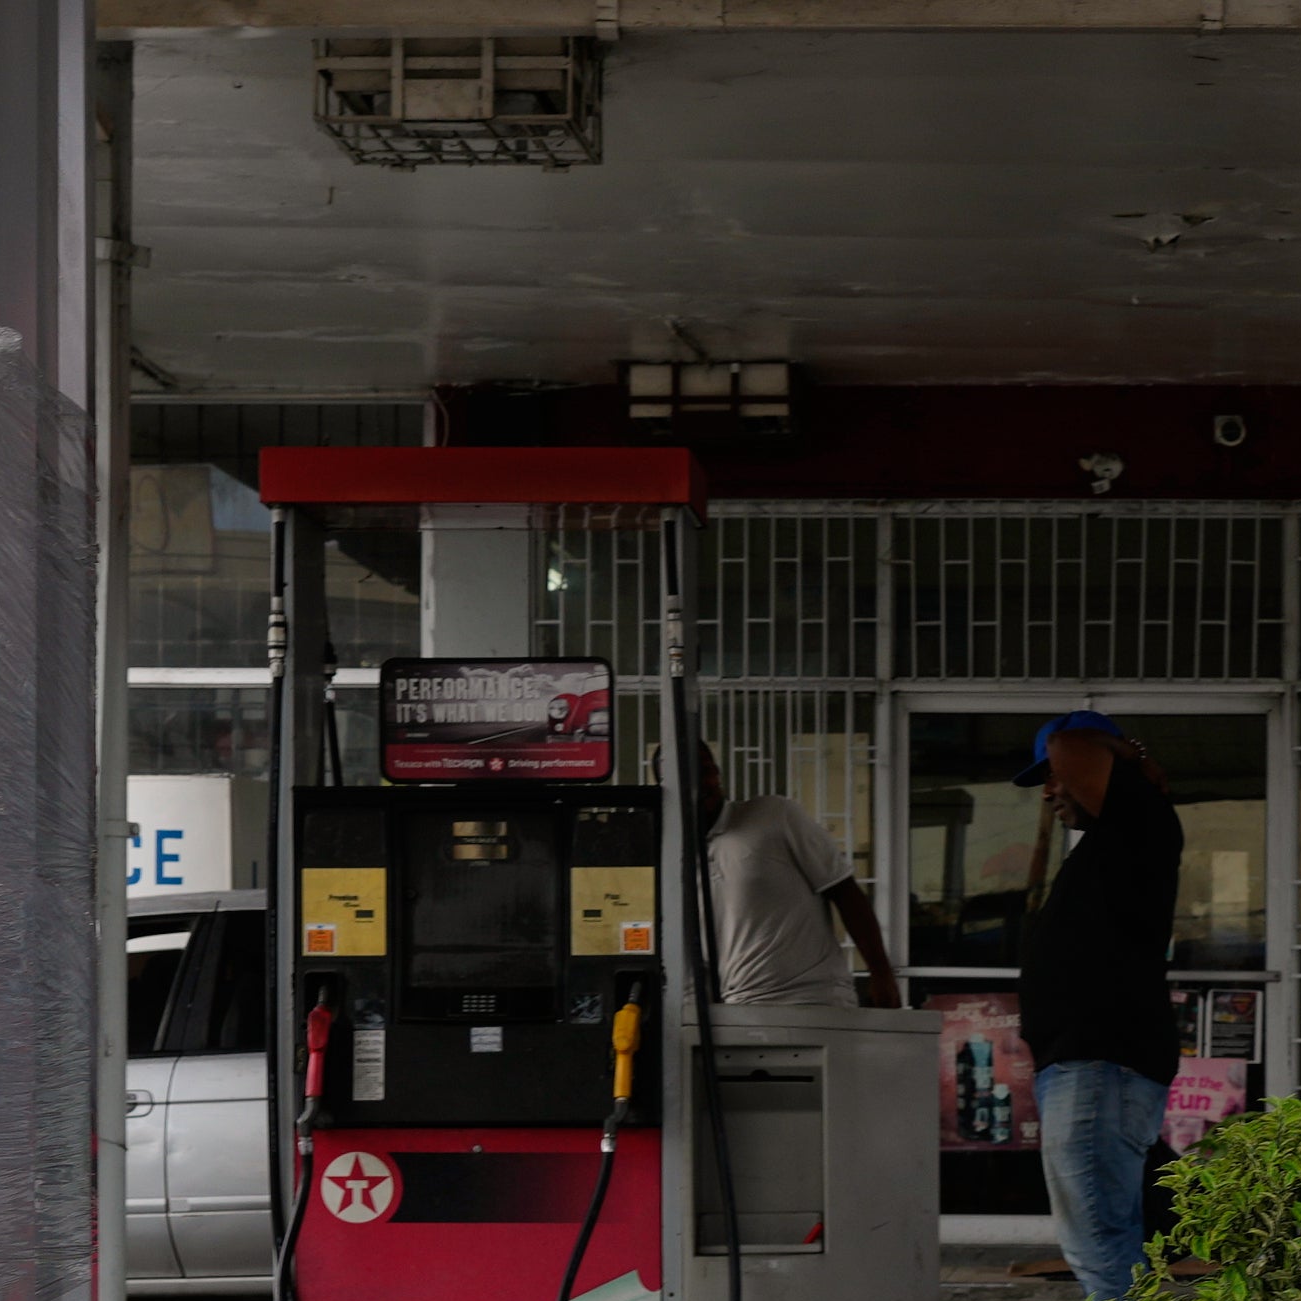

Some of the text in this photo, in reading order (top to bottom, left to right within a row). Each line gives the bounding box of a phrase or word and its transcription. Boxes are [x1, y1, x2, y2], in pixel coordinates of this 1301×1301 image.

[395, 703, 428, 723] IT'S
[433, 703, 476, 723] WHAT
[483, 703, 509, 722] WE
[508, 758, 538, 770] Driving
[541, 759, 596, 770] performance
[1197, 1074, 1224, 1091] the
[1167, 1090, 1211, 1111] Fun
